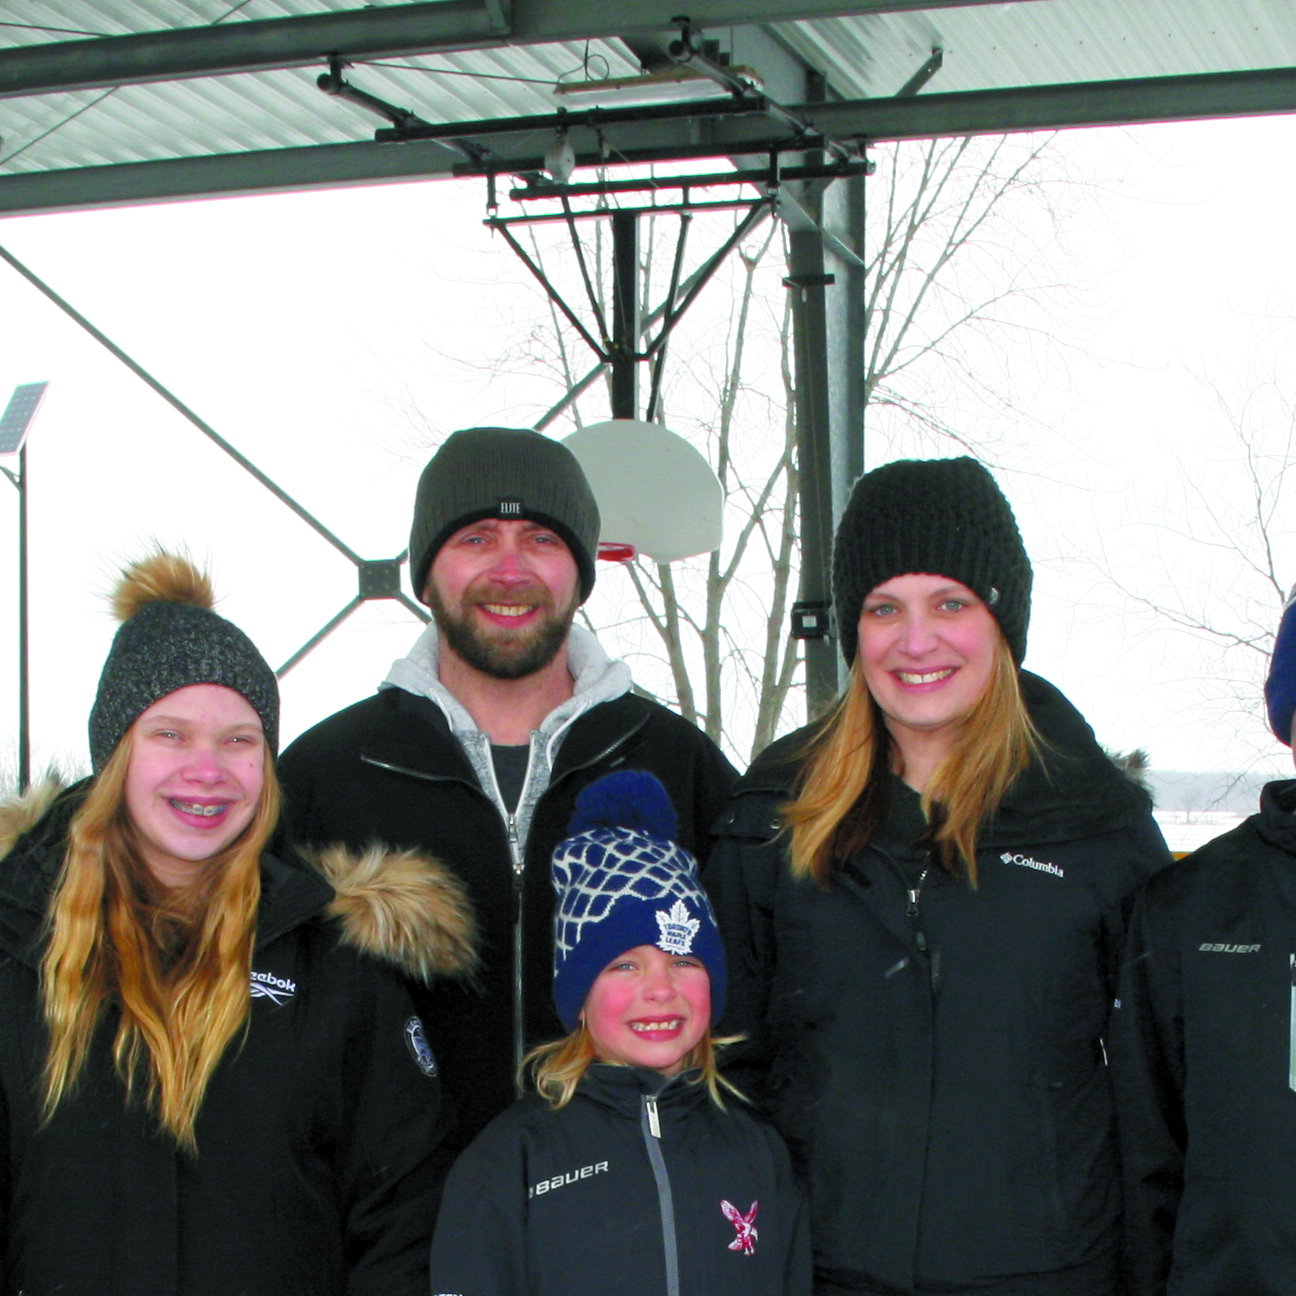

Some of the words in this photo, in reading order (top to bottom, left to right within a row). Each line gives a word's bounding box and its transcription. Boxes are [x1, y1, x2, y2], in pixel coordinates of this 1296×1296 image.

[500, 502, 521, 514] ELITE
[1013, 854, 1064, 878] Columbia
[1198, 943, 1261, 954] BAUER
[250, 971, 296, 993] eebok
[535, 1160, 609, 1196] BAUER
